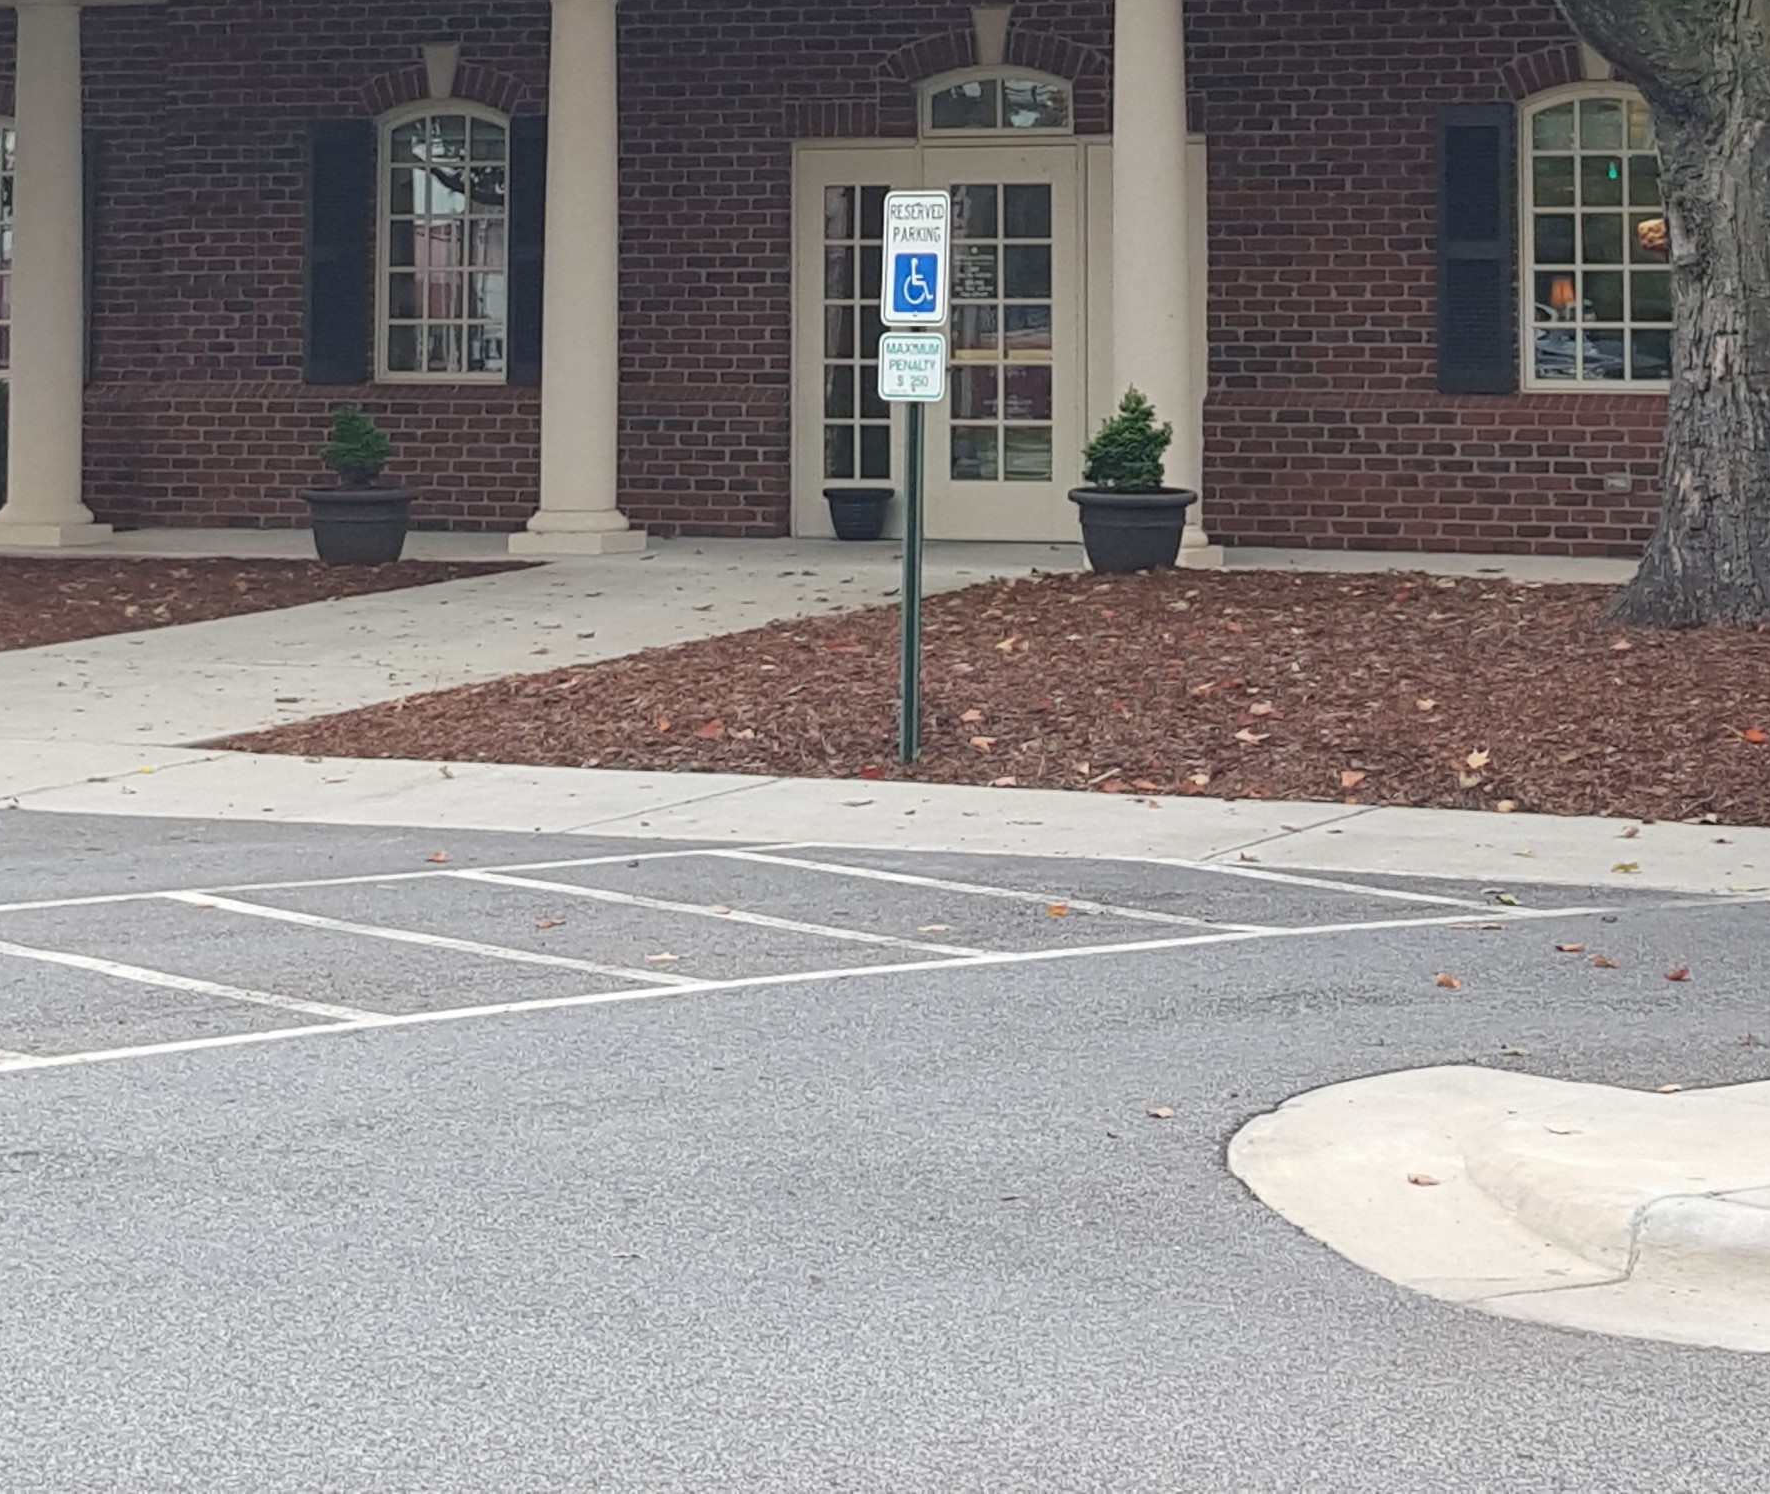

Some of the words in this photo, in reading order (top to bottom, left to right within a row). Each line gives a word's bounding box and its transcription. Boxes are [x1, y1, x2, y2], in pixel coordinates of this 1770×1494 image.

[890, 203, 944, 220] RESERVED
[893, 226, 941, 243] PARKING
[888, 359, 936, 371] PENALTY
